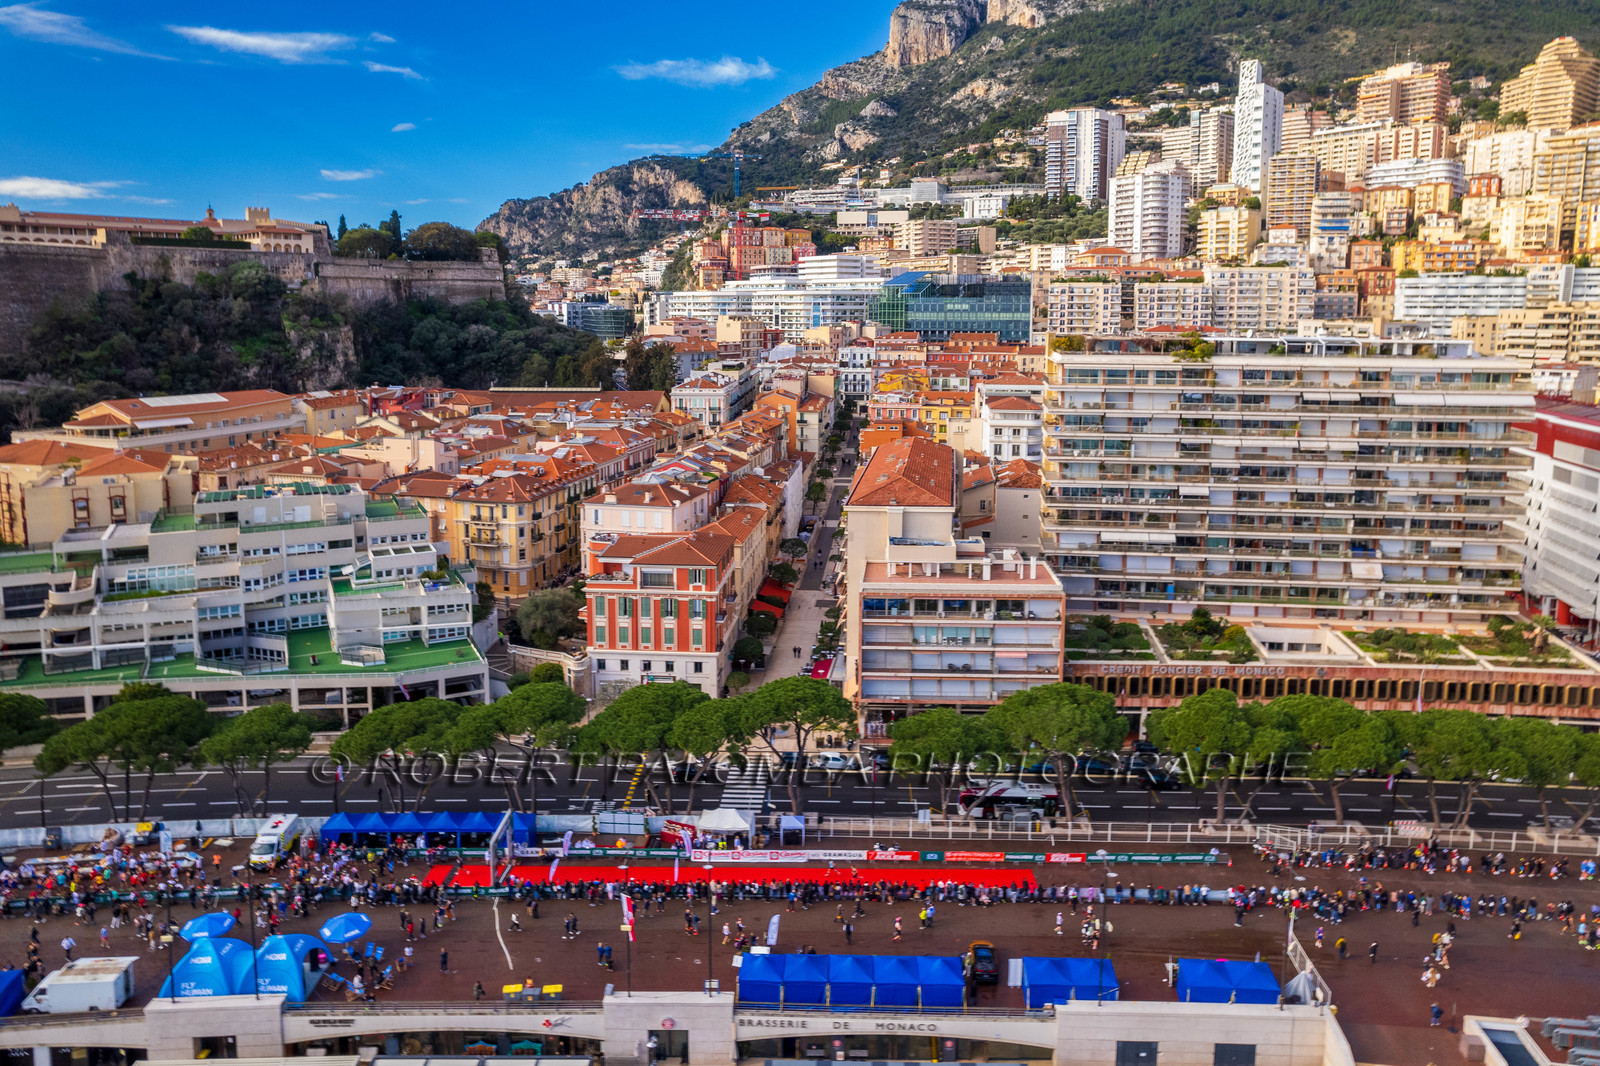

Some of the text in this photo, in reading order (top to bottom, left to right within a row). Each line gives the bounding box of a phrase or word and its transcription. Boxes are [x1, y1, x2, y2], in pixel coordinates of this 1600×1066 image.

[1152, 666, 1203, 675] FONCIER
[1211, 666, 1226, 675] DE
[1235, 666, 1285, 676] MONACO
[738, 1018, 938, 1032] BRASSERIE DE MONACO
